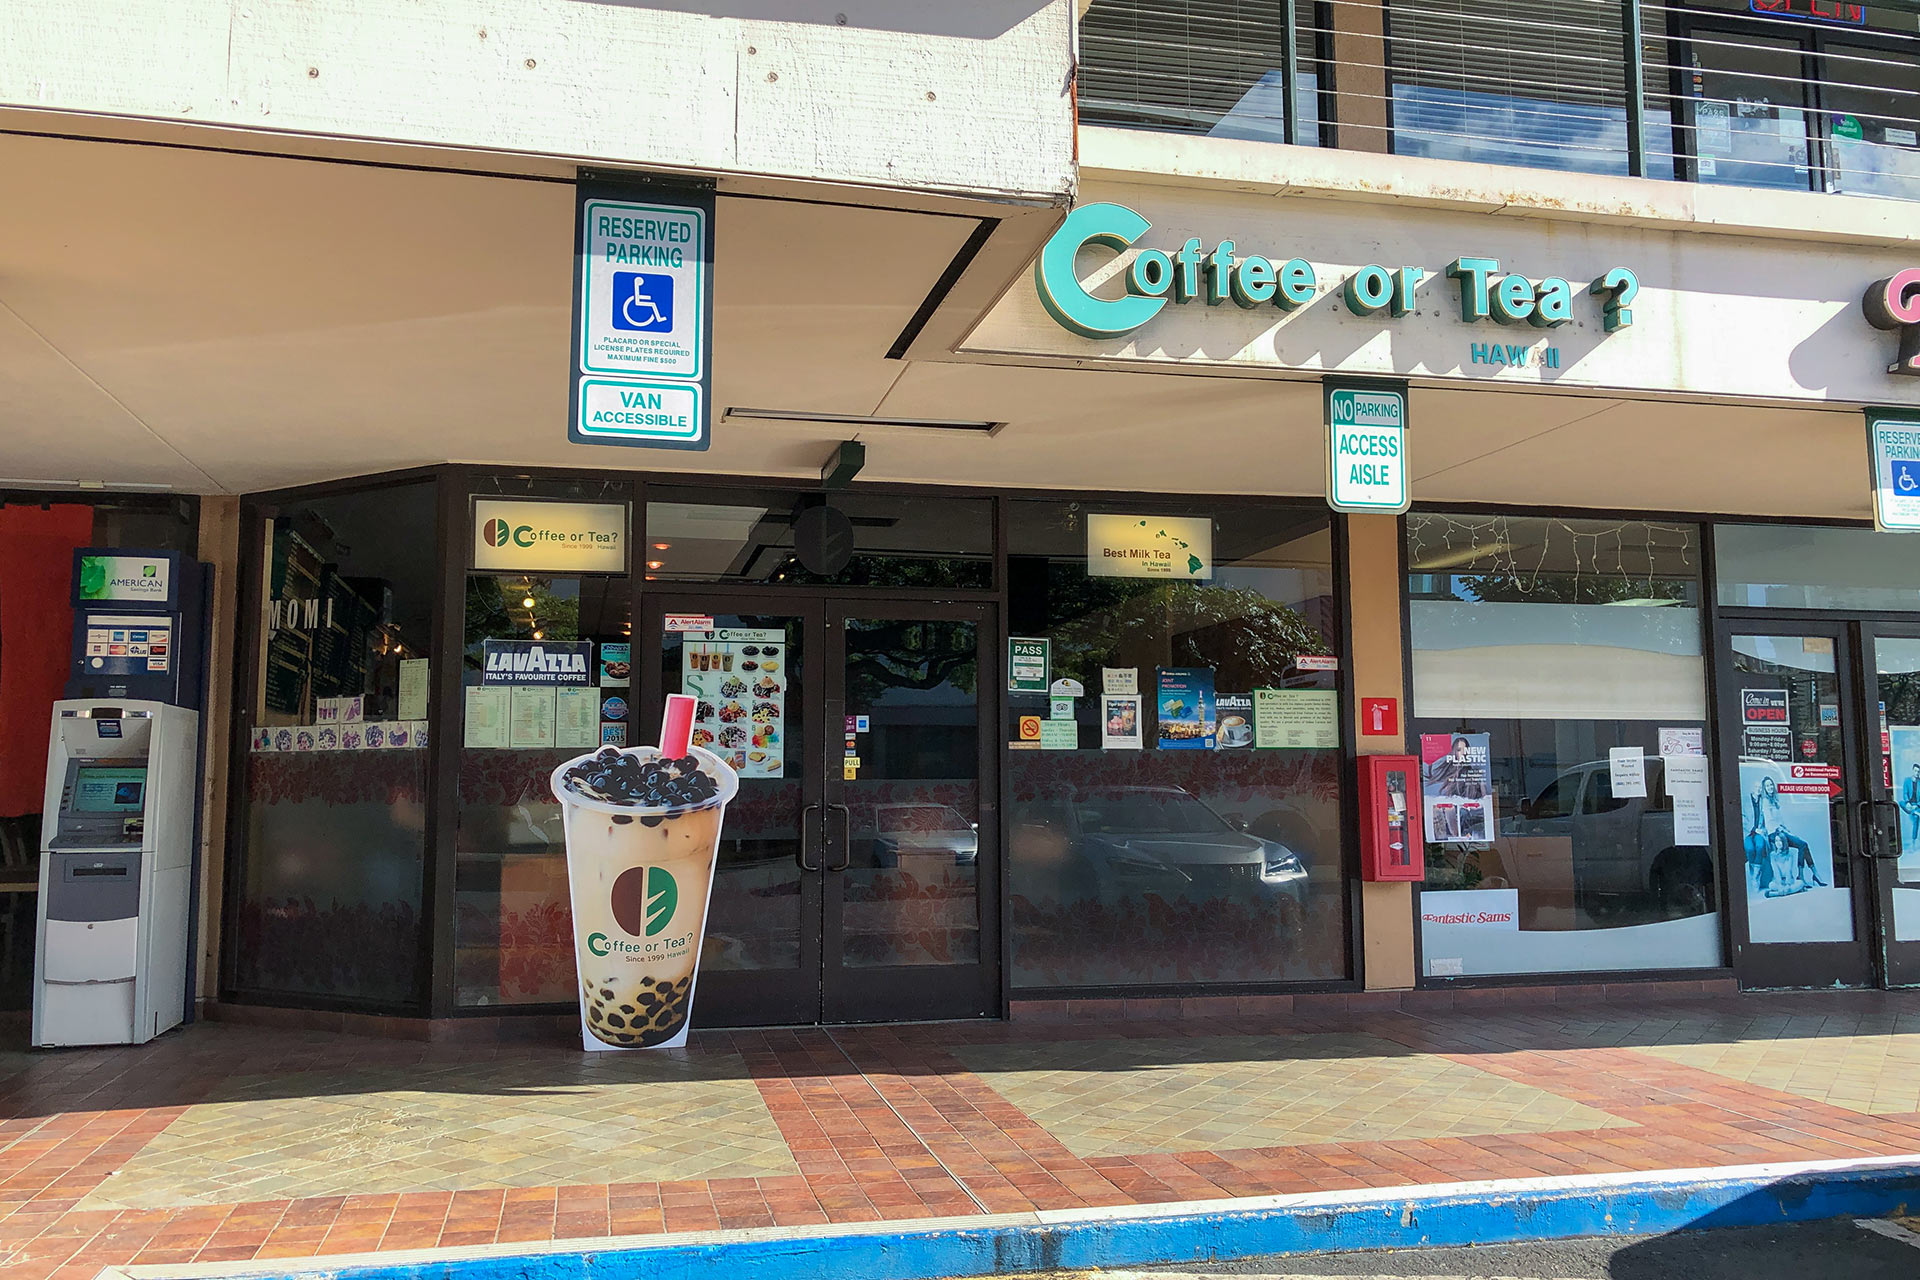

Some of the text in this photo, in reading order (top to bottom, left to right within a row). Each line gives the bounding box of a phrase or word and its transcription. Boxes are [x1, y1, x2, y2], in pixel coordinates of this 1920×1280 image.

[599, 215, 692, 244] RESERVED
[606, 243, 683, 269] PARKING
[1036, 202, 1316, 338] Coffee
[1346, 263, 1424, 317] or
[1448, 256, 1574, 328] Tea
[603, 336, 638, 345] PLACARD
[650, 340, 681, 348] SPECIAL
[594, 344, 690, 357] LICENSE PLATES REQUIRED
[607, 353, 642, 362] MAXIMUM
[620, 391, 662, 410] VAN
[1334, 399, 1398, 421] NO PARKING
[593, 410, 688, 428] ACCESSIBLE
[1339, 433, 1398, 457] ACCESS
[1885, 445, 1920, 459] PARKIN
[1349, 463, 1390, 486] AISLE
[513, 525, 618, 548] Coffee or Tea?
[1103, 548, 1171, 559] Best Milk Tea
[110, 578, 163, 588] AMERICAN
[269, 597, 333, 630] MOMI
[719, 629, 742, 640] Coffee
[1014, 645, 1043, 655] PASS
[486, 646, 586, 673] LAVAZZA
[485, 672, 513, 680] ITALY'S
[514, 673, 556, 681] FAVOURITE
[1215, 695, 1252, 707] LAVAZZA
[1746, 708, 1786, 721] OPEN
[603, 727, 625, 736] BEST
[1463, 746, 1487, 755] NEW
[1446, 754, 1487, 763] PLASTIC
[1421, 911, 1512, 924] Fantastic Sams
[587, 932, 641, 957] Coffee
[645, 942, 659, 953] or
[625, 948, 690, 963] Since 1999 Hawaii
